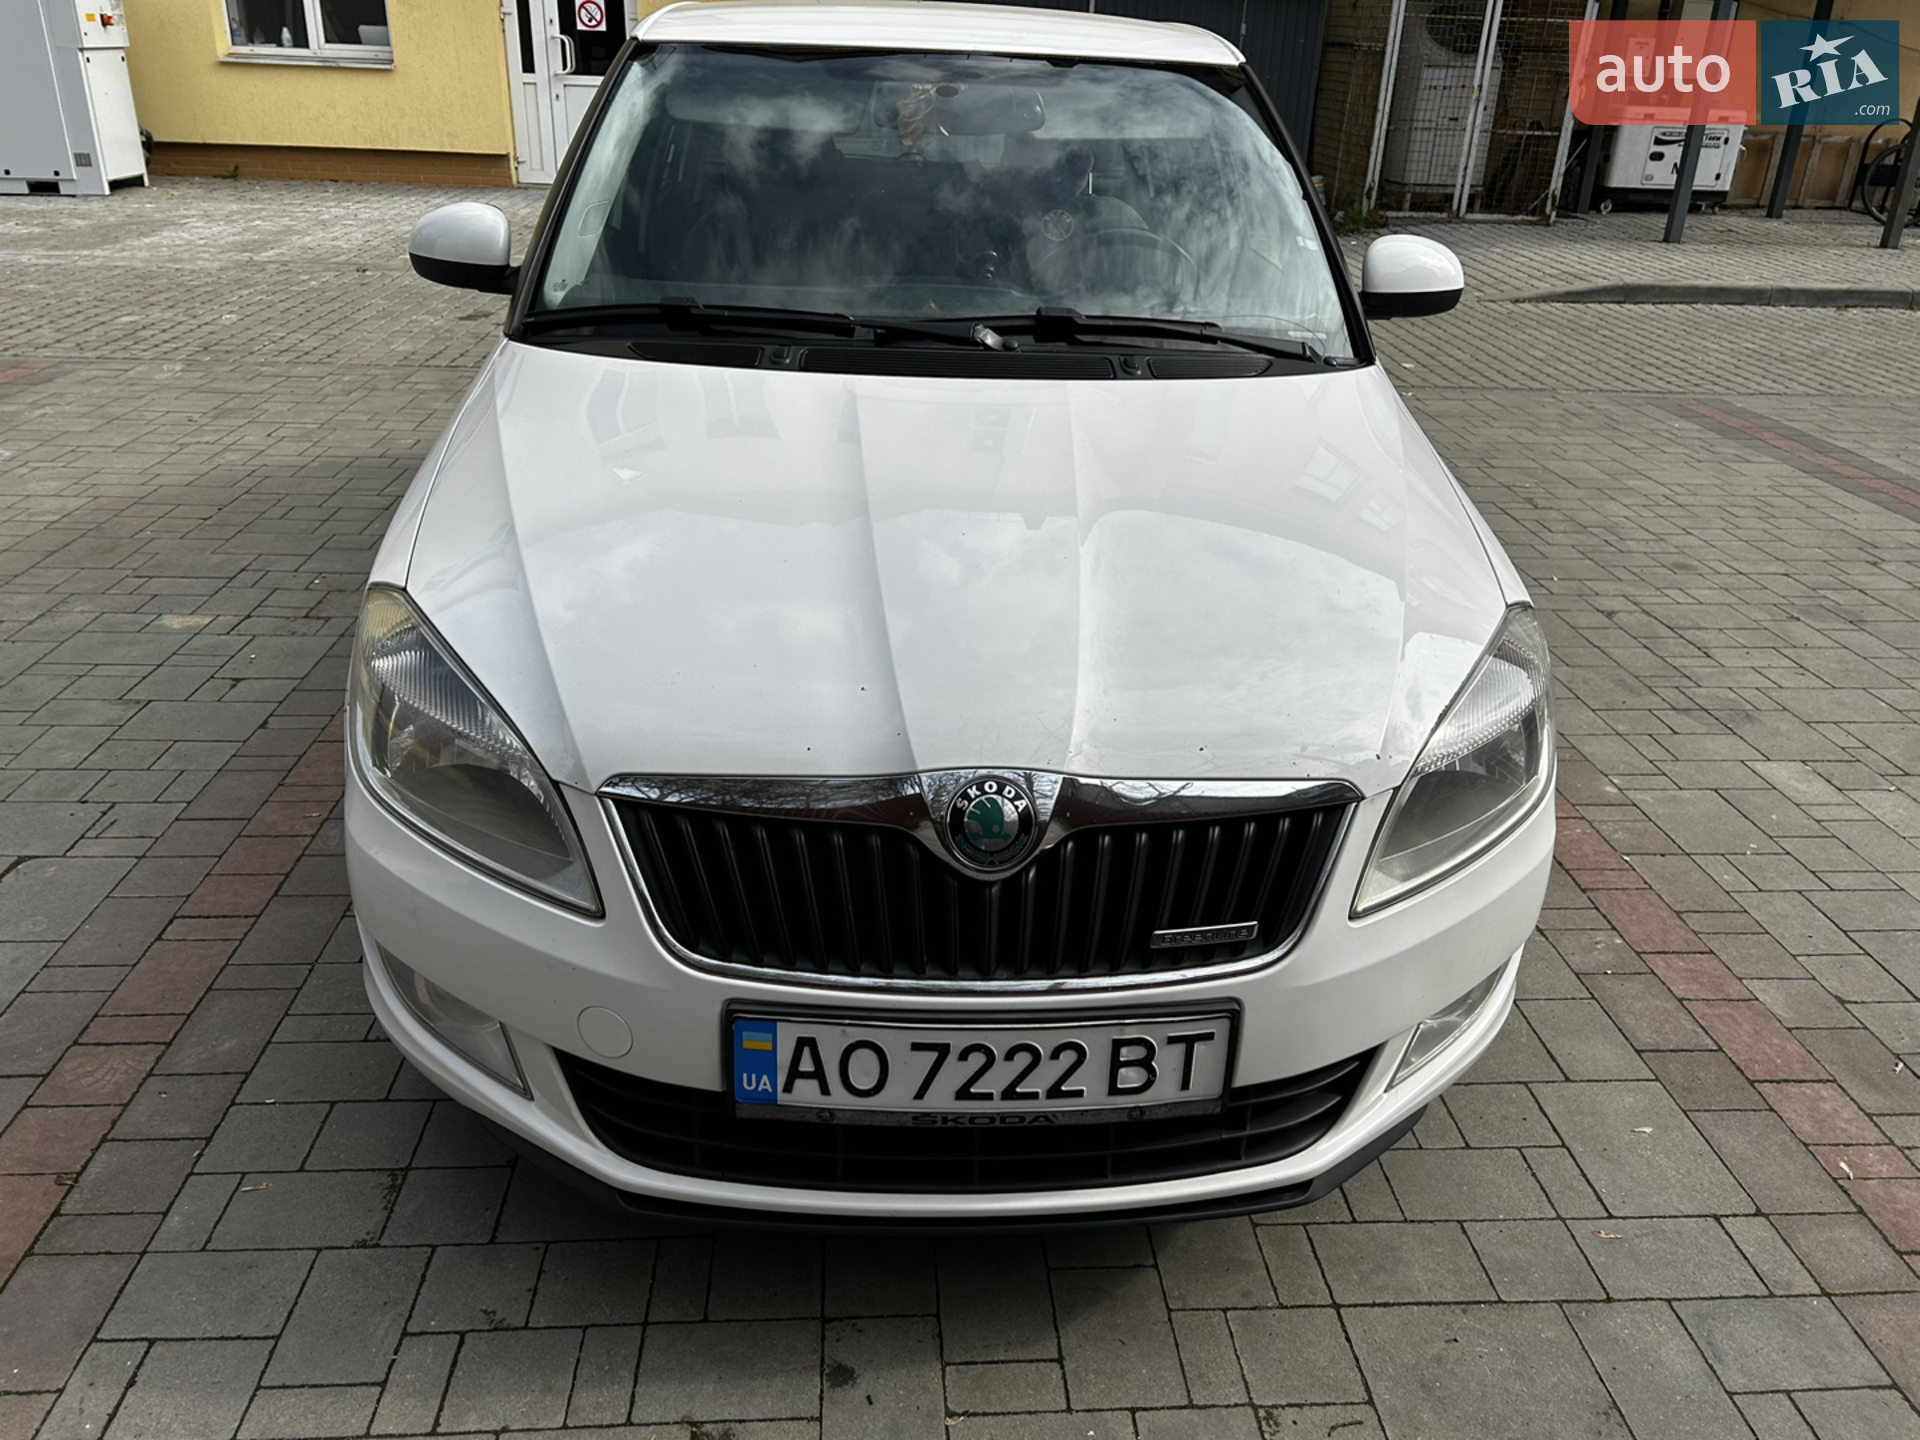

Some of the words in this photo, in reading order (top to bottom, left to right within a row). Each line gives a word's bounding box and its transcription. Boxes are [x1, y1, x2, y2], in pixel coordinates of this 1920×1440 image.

[742, 1072, 773, 1094] UA
[782, 1036, 890, 1098] AO
[910, 1042, 1088, 1101] 7222
[1106, 1031, 1217, 1097] BT
